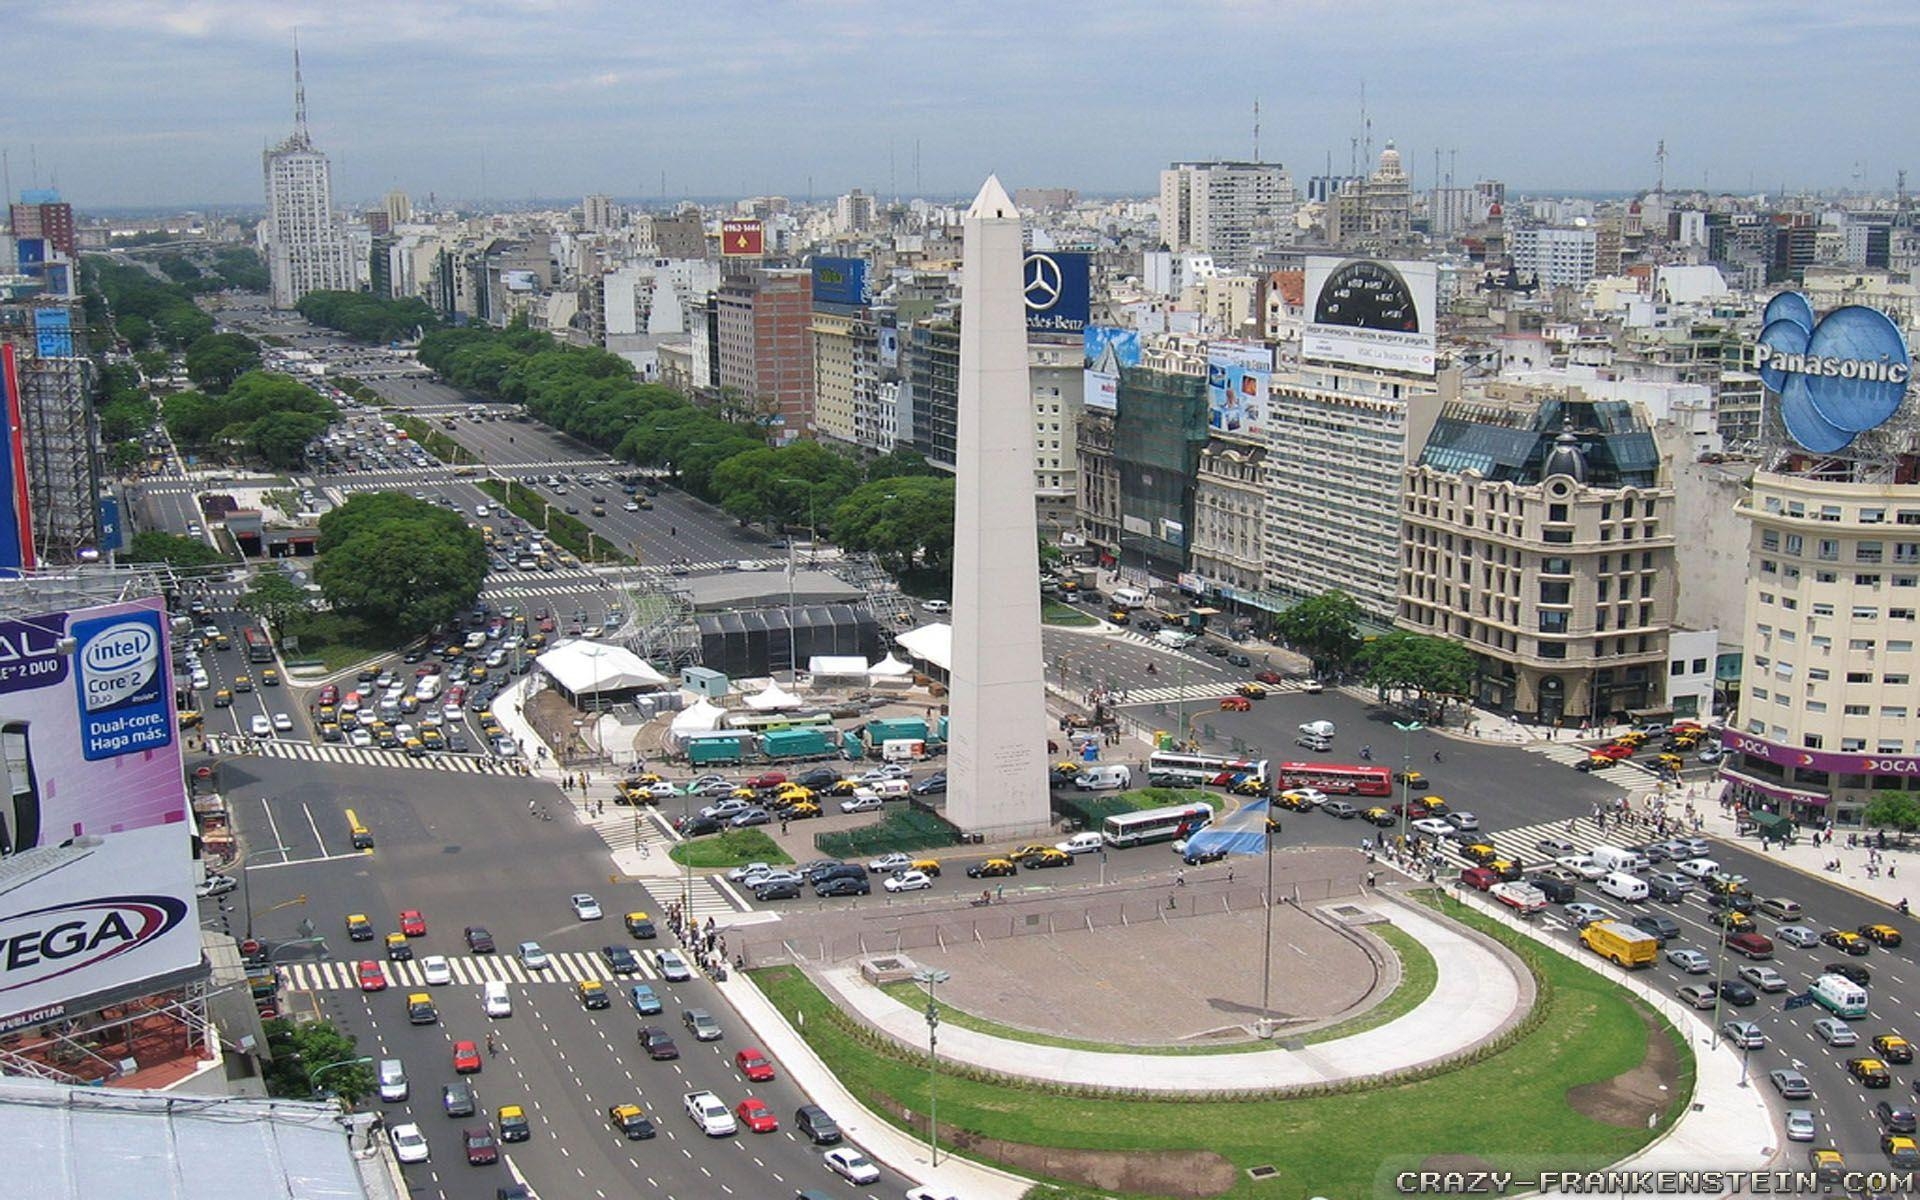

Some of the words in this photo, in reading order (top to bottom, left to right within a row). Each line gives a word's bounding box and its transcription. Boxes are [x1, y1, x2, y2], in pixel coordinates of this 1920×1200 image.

[1753, 342, 1908, 383] Panasonic
[95, 636, 141, 661] intel
[20, 665, 28, 676] 2
[30, 659, 58, 675] DUO
[132, 672, 141, 687] 2
[89, 693, 113, 706] Duo
[90, 712, 164, 735] Dual-core.
[90, 735, 129, 752] Haga
[132, 727, 166, 743] más.
[1744, 740, 1770, 757] OCA
[1879, 760, 1918, 772] OCA
